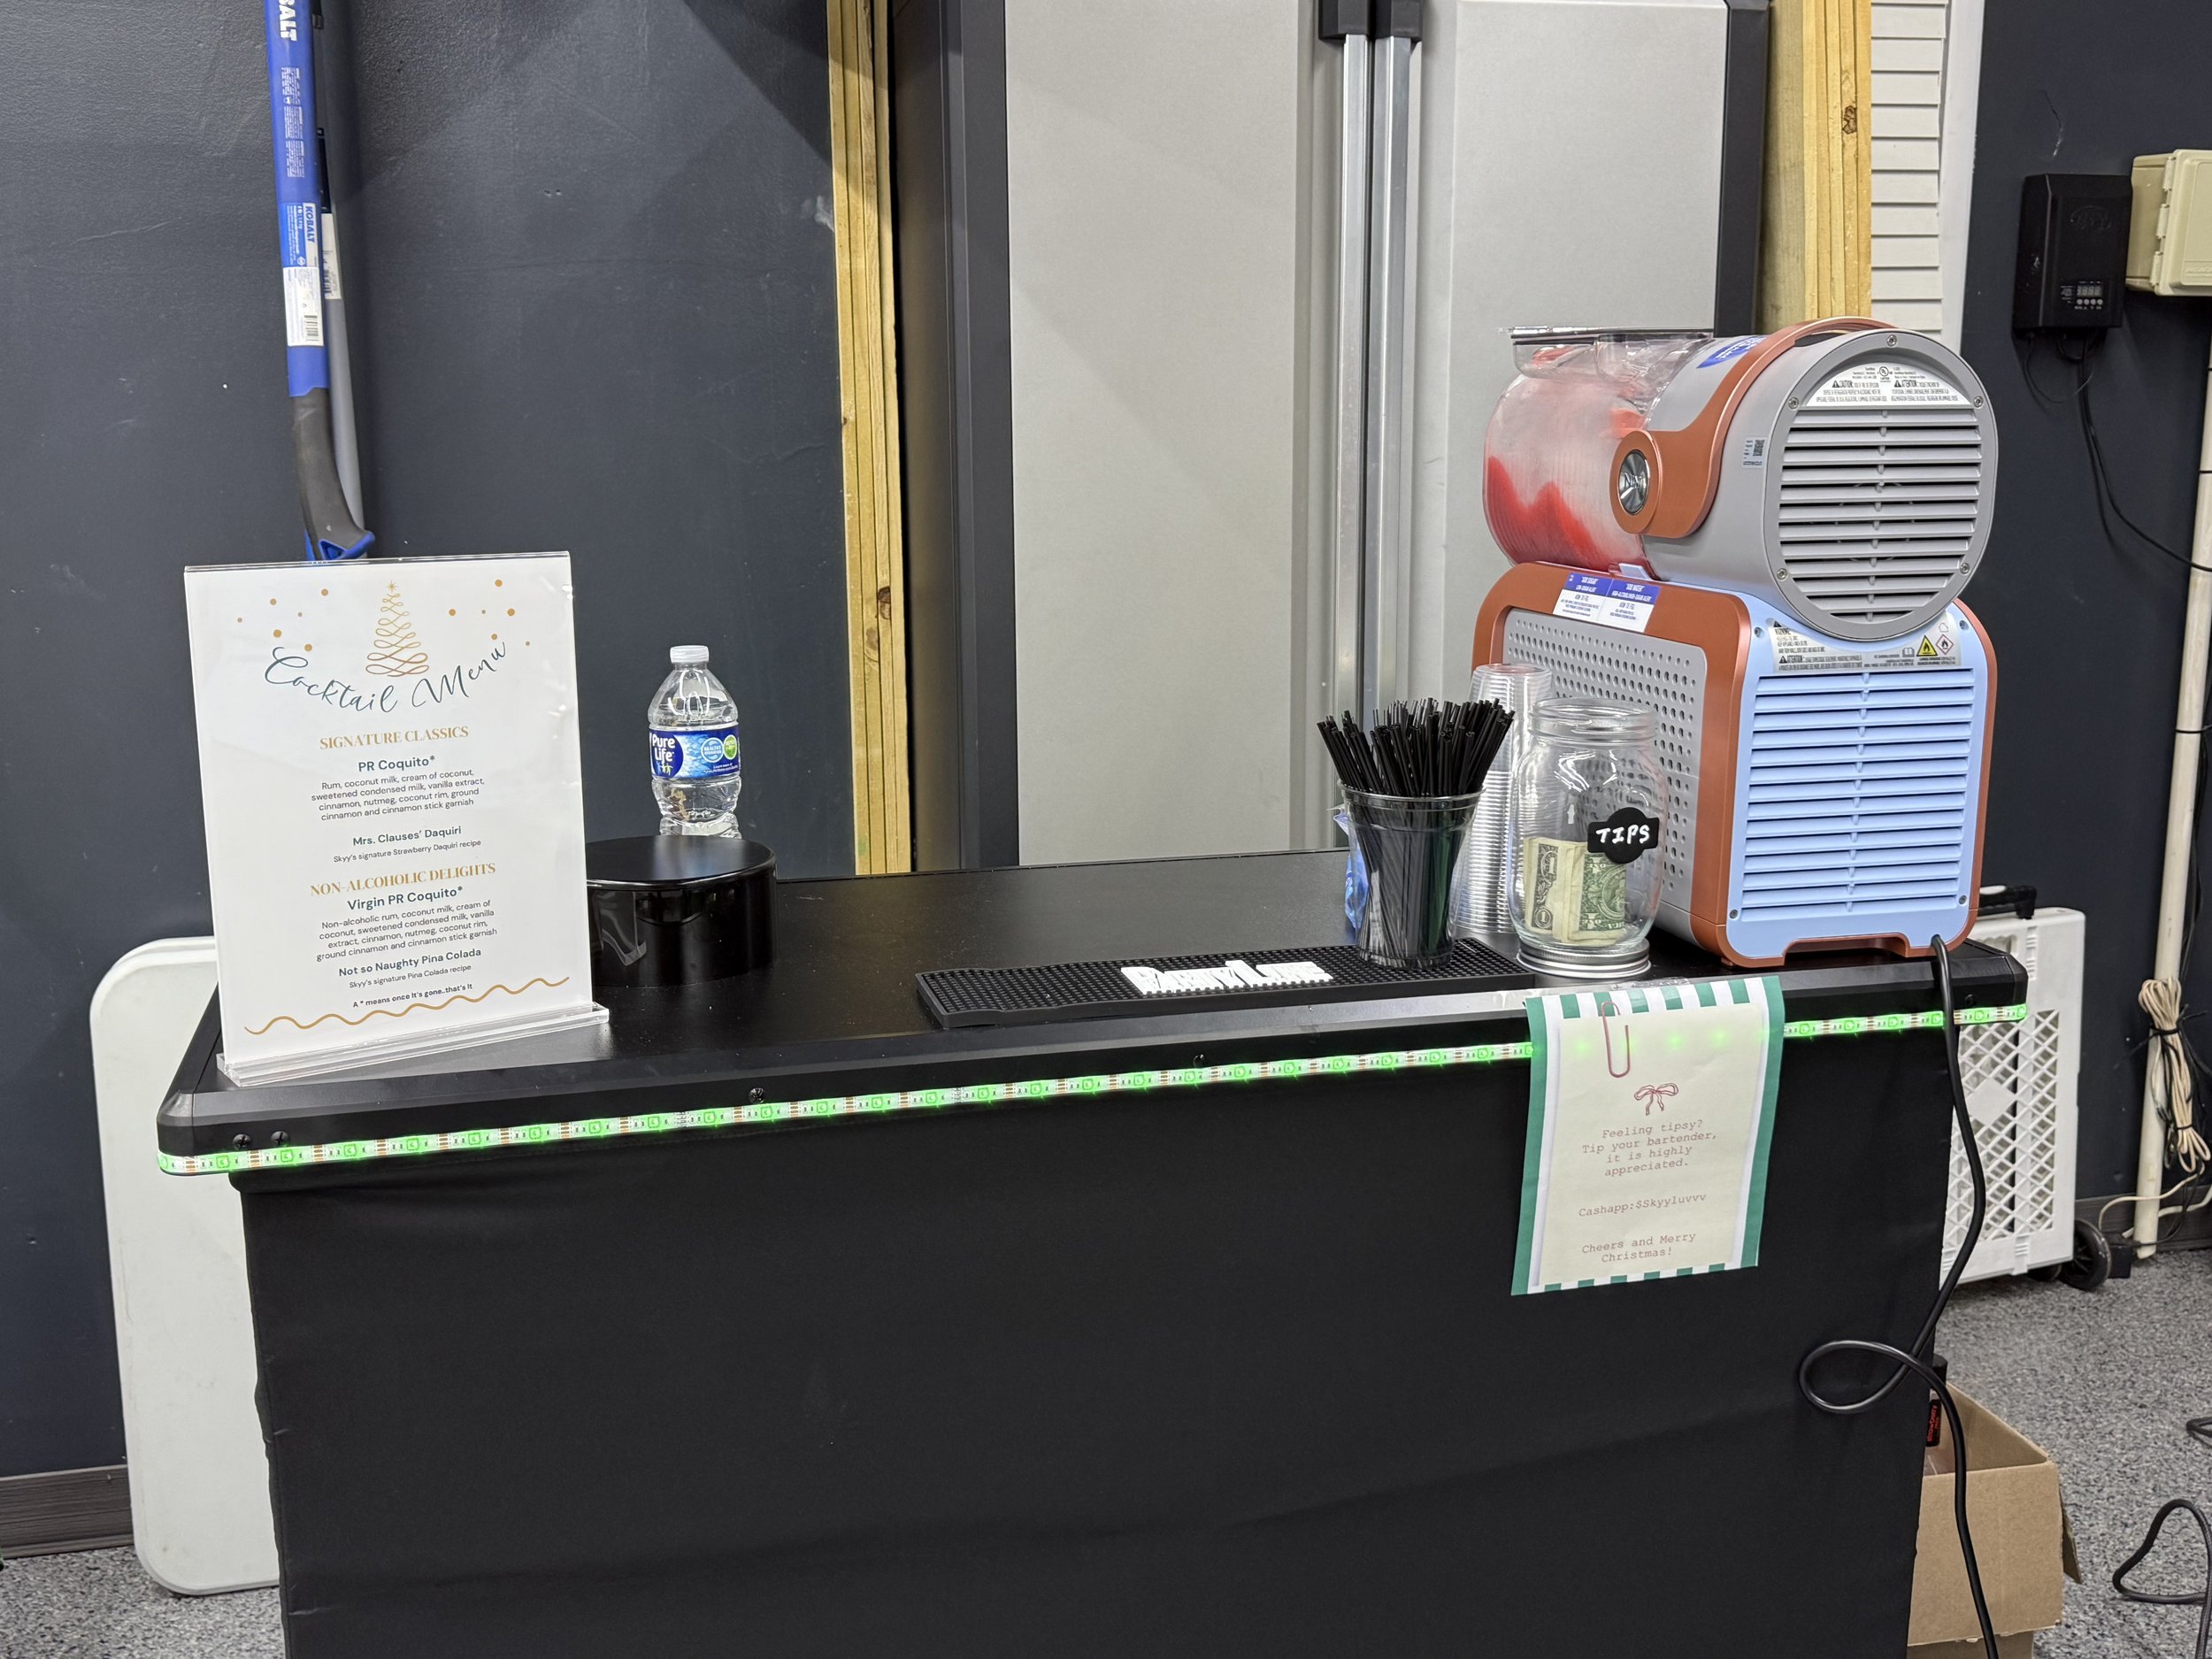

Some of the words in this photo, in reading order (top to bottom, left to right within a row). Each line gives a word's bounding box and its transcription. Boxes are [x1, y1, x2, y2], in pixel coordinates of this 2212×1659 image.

[305, 205, 315, 242] KOBALT
[265, 647, 398, 713] Cocktail
[411, 641, 506, 707] Menu
[319, 731, 402, 749] SIGNATURE
[404, 726, 469, 742] CLASSICS
[651, 733, 676, 749] Pure
[358, 761, 375, 772] PR
[655, 747, 673, 764] Life
[344, 779, 379, 787] coconut
[380, 775, 400, 784] milk,
[439, 770, 474, 779] coconut,
[311, 789, 358, 802] sweetened
[359, 786, 406, 796] condensed
[427, 780, 453, 789] vanilla
[319, 801, 361, 810] cinnamon,
[364, 796, 397, 806] nutmeg,
[398, 793, 433, 803] coconut
[451, 787, 480, 799] ground
[320, 810, 363, 821] cinnamon
[365, 807, 380, 816] and
[382, 804, 423, 814] cinnamon
[425, 801, 444, 810] stick
[445, 798, 474, 809] garnish
[352, 837, 375, 847] Mrs.
[378, 830, 422, 844] Clauses'
[425, 826, 462, 839] Daquiri
[1595, 825, 1650, 844] TIPS
[333, 853, 357, 864] Skyy's
[358, 849, 392, 860] signature
[393, 846, 432, 856] Strawberry
[434, 842, 458, 851] Daquiri
[459, 840, 481, 849] recipe
[311, 871, 428, 897] NON-ALCOHOLIC
[429, 862, 496, 881] DELIGHTS
[347, 897, 385, 911] Virgin
[388, 894, 404, 905] PR
[319, 929, 356, 940] coconut,
[357, 921, 403, 934] sweetened
[404, 915, 449, 927] condensed
[470, 910, 495, 918] vanilla
[322, 916, 380, 929] Non-alcoholic
[402, 908, 435, 918] coconut
[437, 904, 455, 913] milk,
[457, 902, 481, 911] cream
[317, 949, 347, 963] ground
[349, 944, 388, 956] cinnamon
[407, 936, 448, 947] cinnamon
[449, 933, 467, 941] stick
[469, 928, 497, 940] garnish
[327, 939, 359, 949] extract,
[361, 933, 403, 943] cinnamon,
[404, 927, 437, 938] nutmeg,
[439, 922, 472, 933] coconut
[339, 966, 357, 977] Not
[375, 957, 419, 971] Naughty
[421, 954, 444, 964] Pina
[446, 949, 481, 961] Colada
[349, 979, 373, 989] Skyy's
[373, 975, 406, 986] signature
[424, 968, 449, 977] Colada
[449, 964, 472, 973] recipe
[365, 997, 390, 1006] means
[1602, 1126, 1653, 1139] Feeling
[1661, 1120, 1703, 1133] tipsy?
[1582, 1144, 1605, 1155] Tip
[1612, 1141, 1640, 1152] your
[1647, 1132, 1717, 1147] bartender,
[1628, 1152, 1642, 1161] is
[1649, 1145, 1693, 1158] highly
[1605, 1158, 1688, 1177] appreciated.
[1582, 1240, 1624, 1254] Cheers
[1632, 1237, 1653, 1248] and
[1660, 1233, 1696, 1244] Merry
[1601, 1247, 1672, 1263] Christmas!
